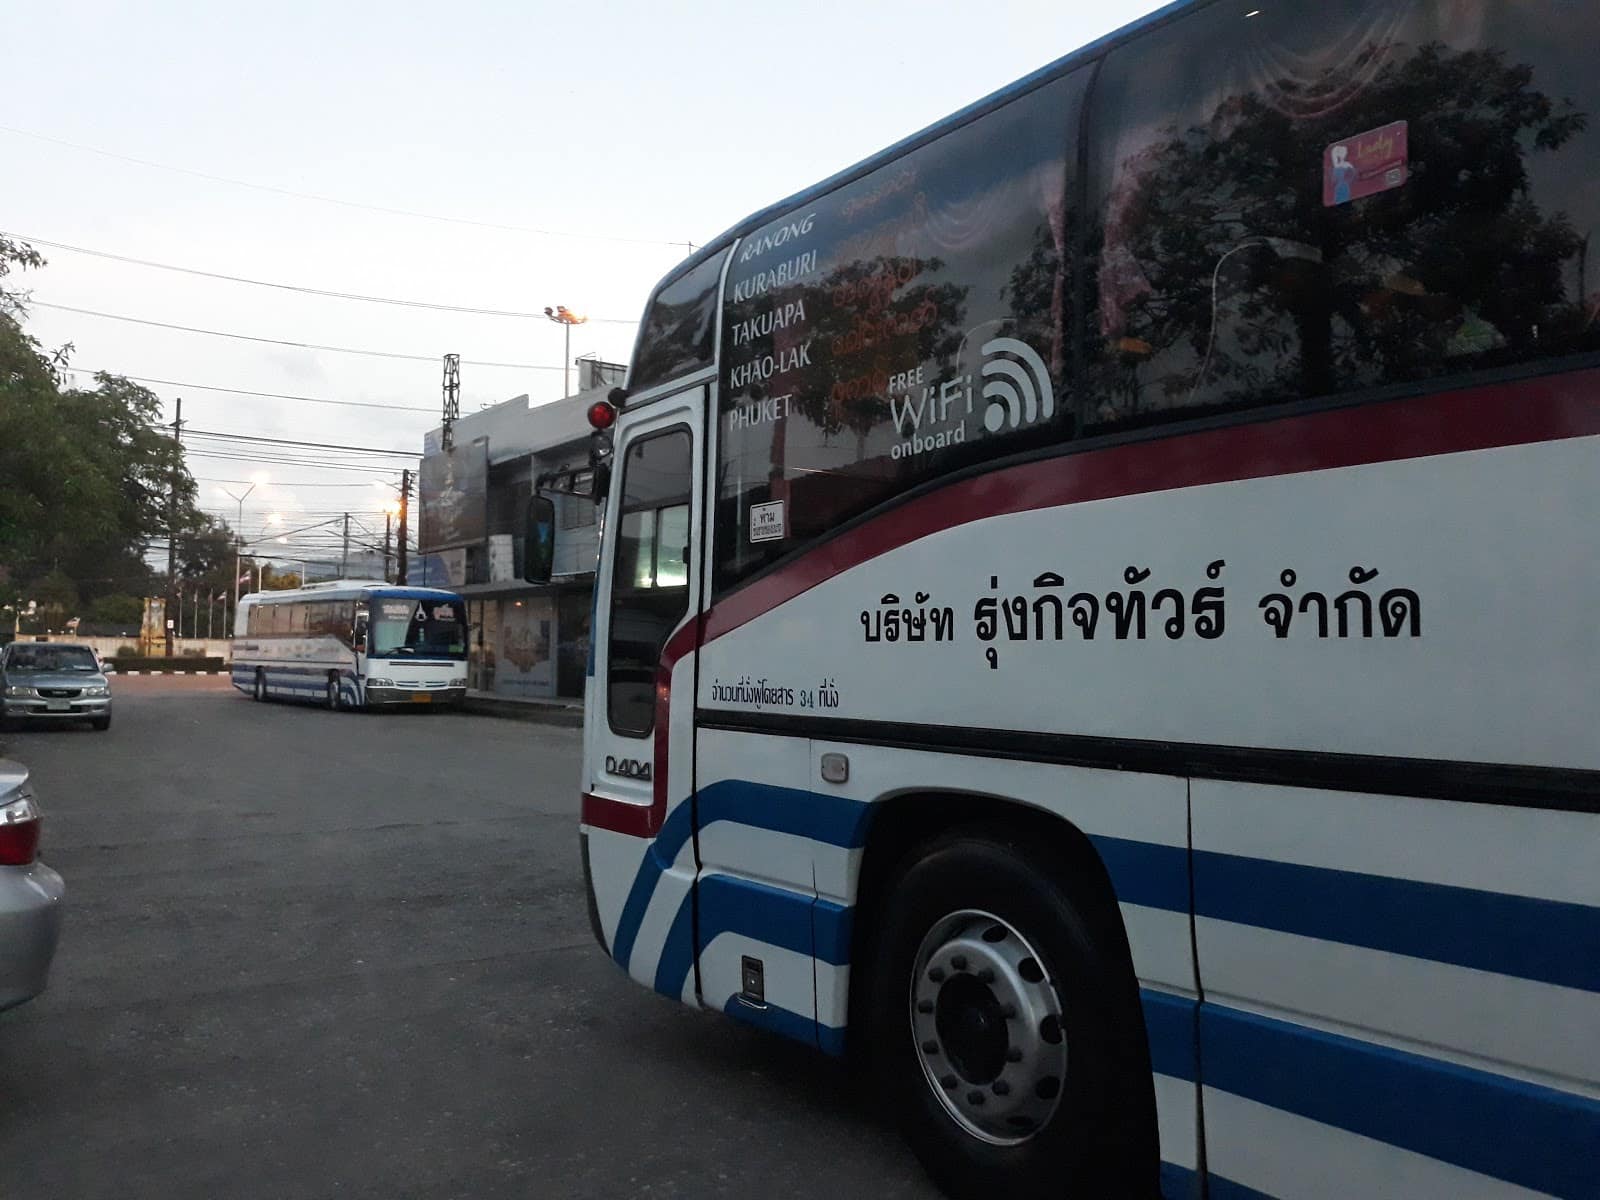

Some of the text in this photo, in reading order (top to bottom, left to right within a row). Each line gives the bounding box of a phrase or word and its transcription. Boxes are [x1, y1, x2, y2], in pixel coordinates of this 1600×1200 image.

[734, 249, 817, 304] KURABURI
[731, 299, 806, 346] TAKUAPA
[730, 341, 811, 390] KHAO-LAK
[889, 366, 924, 393] FREE
[730, 393, 793, 432] PHUKET
[890, 374, 973, 434] WiFi
[891, 419, 966, 460] onboard
[860, 559, 1422, 670] บริษัท รุ่งกิจทัวร์ จำกัด
[800, 689, 814, 709] 34
[818, 677, 840, 708] ที่นั่ง
